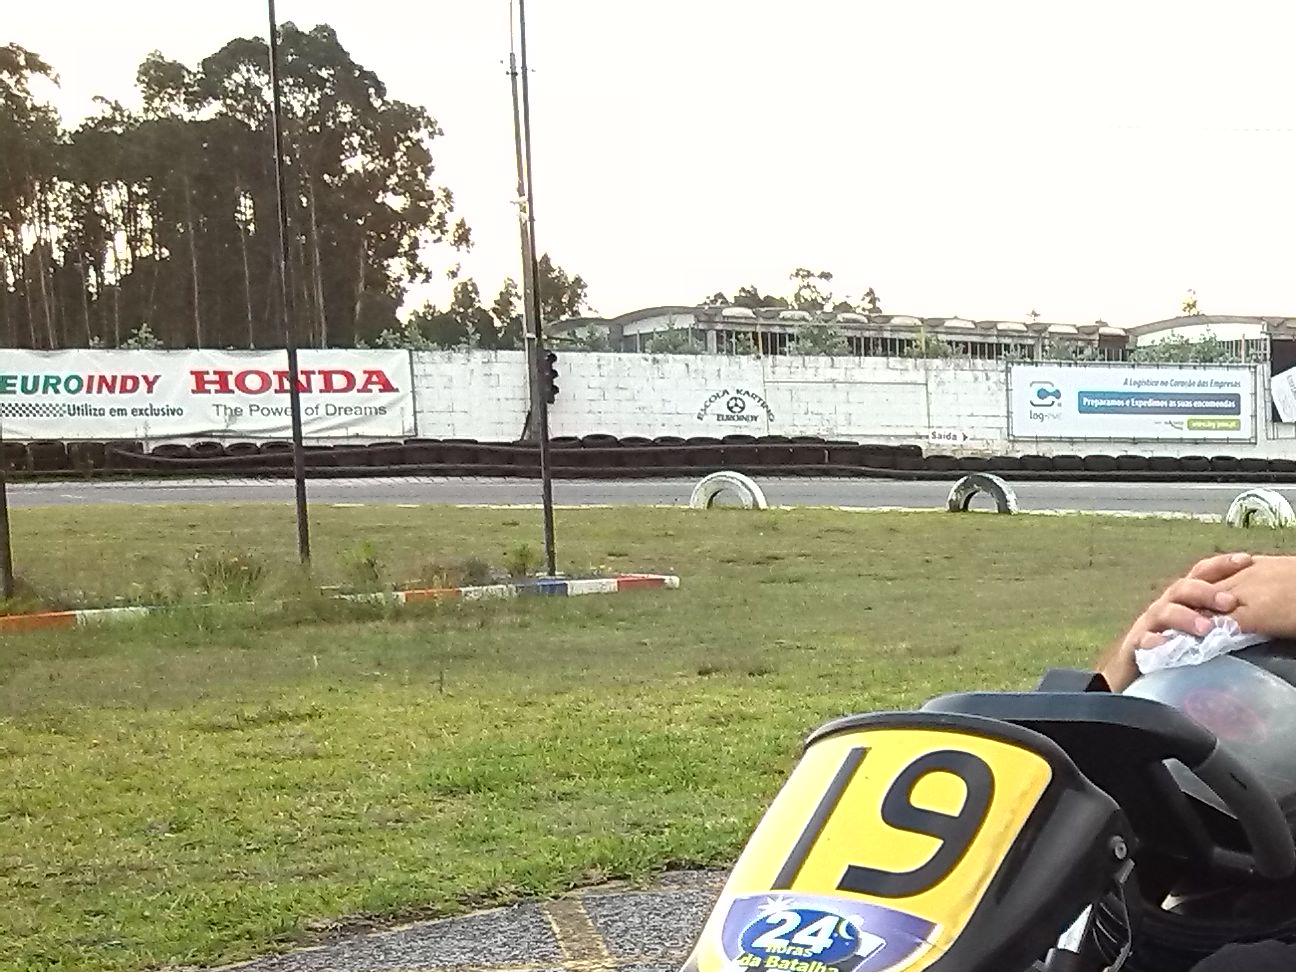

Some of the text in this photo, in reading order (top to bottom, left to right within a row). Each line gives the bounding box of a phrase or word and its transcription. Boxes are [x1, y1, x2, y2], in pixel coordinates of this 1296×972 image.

[0, 374, 162, 395] EUROINDY
[190, 370, 400, 395] HONDA
[1210, 379, 1241, 389] Empresas
[67, 403, 184, 417] Utiliza em exclusivo
[212, 403, 388, 417] The Powe of Dreams
[1082, 397, 1125, 408] Preparamos
[770, 746, 996, 900] 19
[751, 909, 840, 954] 24
[737, 952, 762, 967] da
